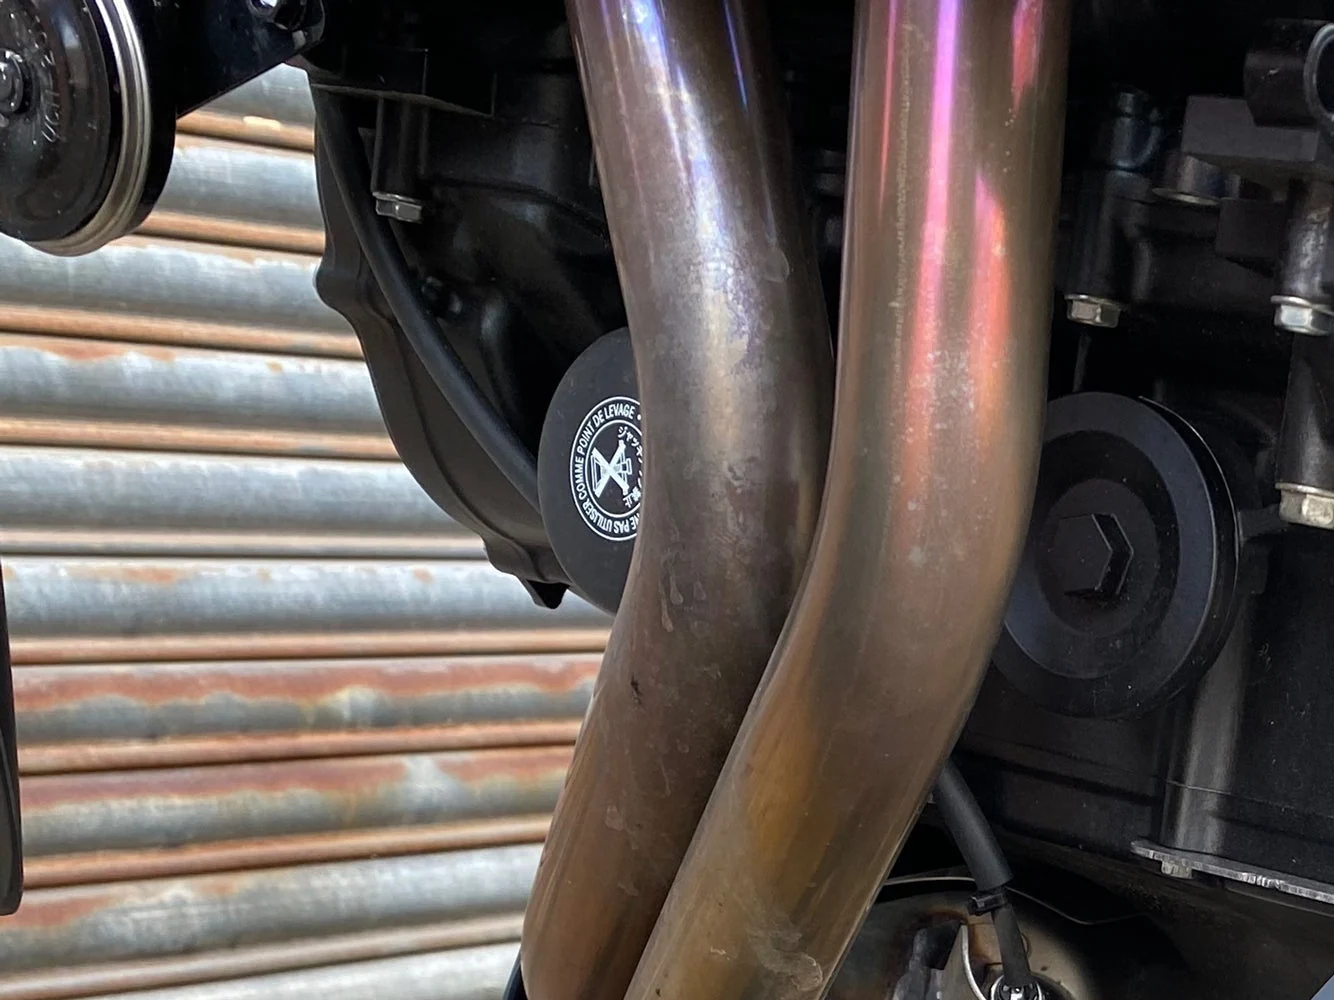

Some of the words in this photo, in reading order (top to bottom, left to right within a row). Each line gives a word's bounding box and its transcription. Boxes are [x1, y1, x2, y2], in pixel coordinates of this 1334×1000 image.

[592, 409, 605, 428] DE
[604, 403, 635, 420] LEVAGE
[577, 421, 595, 456] POINT
[574, 456, 588, 501] COMME
[582, 501, 612, 533] UTILISER
[614, 520, 630, 534] PAS
